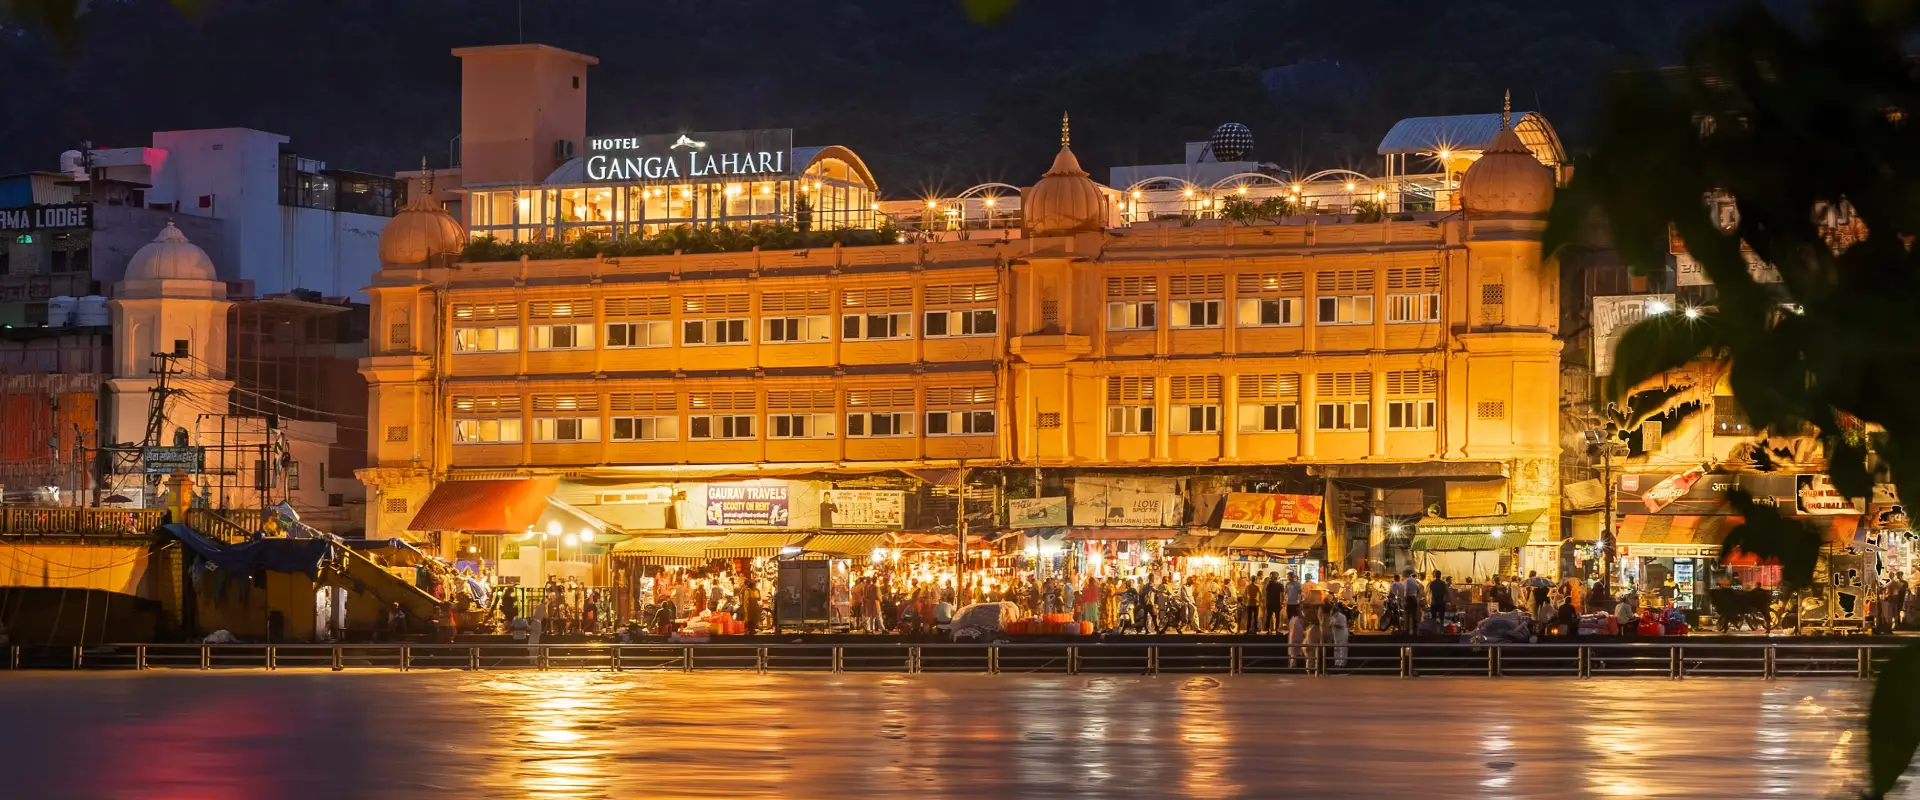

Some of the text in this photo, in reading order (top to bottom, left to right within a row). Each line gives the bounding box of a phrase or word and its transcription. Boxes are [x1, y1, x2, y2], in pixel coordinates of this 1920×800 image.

[592, 138, 640, 149] HOTEL
[587, 151, 784, 181] GANGA LAHARI
[36, 207, 87, 228] LODGE
[708, 487, 787, 500] GAURAV TRAVELS
[723, 501, 770, 511] SCOOTY ON RENT
[1133, 500, 1159, 508] I LOVE
[1264, 525, 1306, 533] BHOJNALAYA
